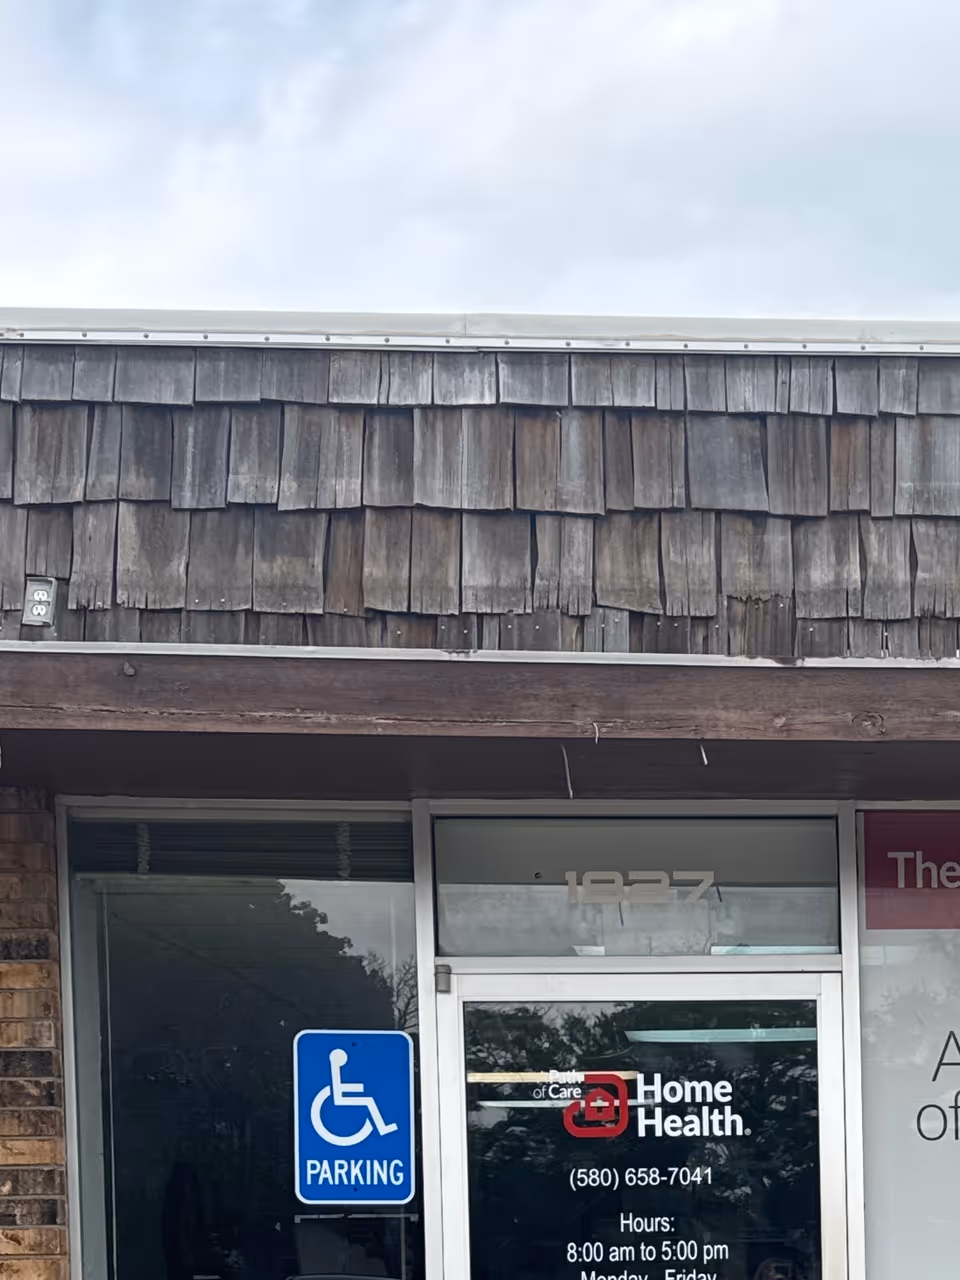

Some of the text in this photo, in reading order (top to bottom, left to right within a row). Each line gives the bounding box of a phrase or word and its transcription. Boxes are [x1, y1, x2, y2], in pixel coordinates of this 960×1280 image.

[532, 1084, 582, 1099] of Care
[636, 1072, 733, 1104] Home
[306, 1159, 404, 1186] PARKING
[569, 1166, 713, 1191] (580) 658-7041
[619, 1212, 676, 1233] Hours:
[566, 1240, 729, 1265] 8:00 am to 5:00 pm
